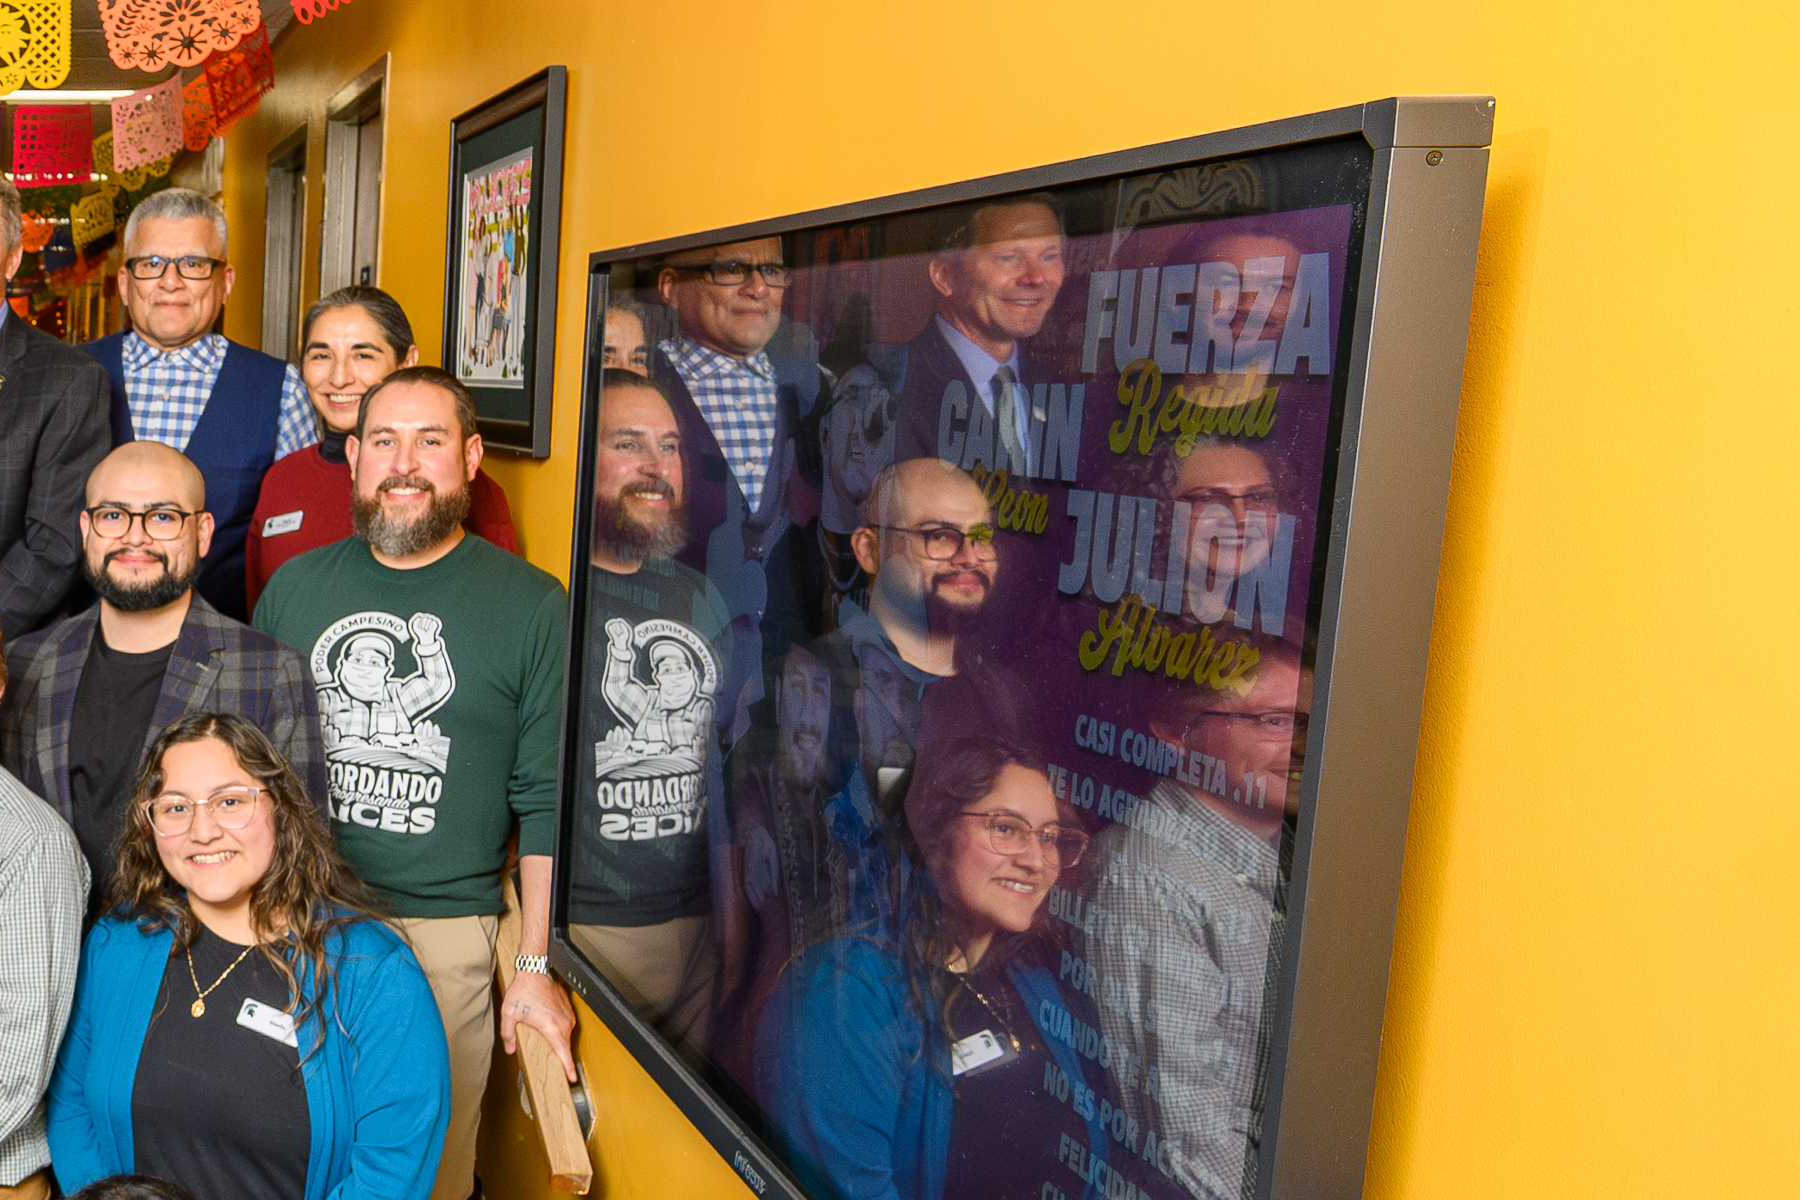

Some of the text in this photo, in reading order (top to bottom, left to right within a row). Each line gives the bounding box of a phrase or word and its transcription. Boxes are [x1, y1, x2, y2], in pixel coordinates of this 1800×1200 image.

[1082, 253, 1331, 375] FUERZA
[315, 615, 404, 674] PODER CAMPESINO
[326, 760, 444, 805] ORDANDO
[1074, 713, 1116, 759] CASI
[1119, 731, 1228, 799] COMPLETA
[1070, 776, 1095, 811] LO
[1059, 949, 1098, 1003] POR
[1039, 999, 1113, 1069] CUANDO
[1043, 1060, 1070, 1103] NO
[1073, 1080, 1096, 1122] ES
[1099, 1099, 1138, 1153] POR
